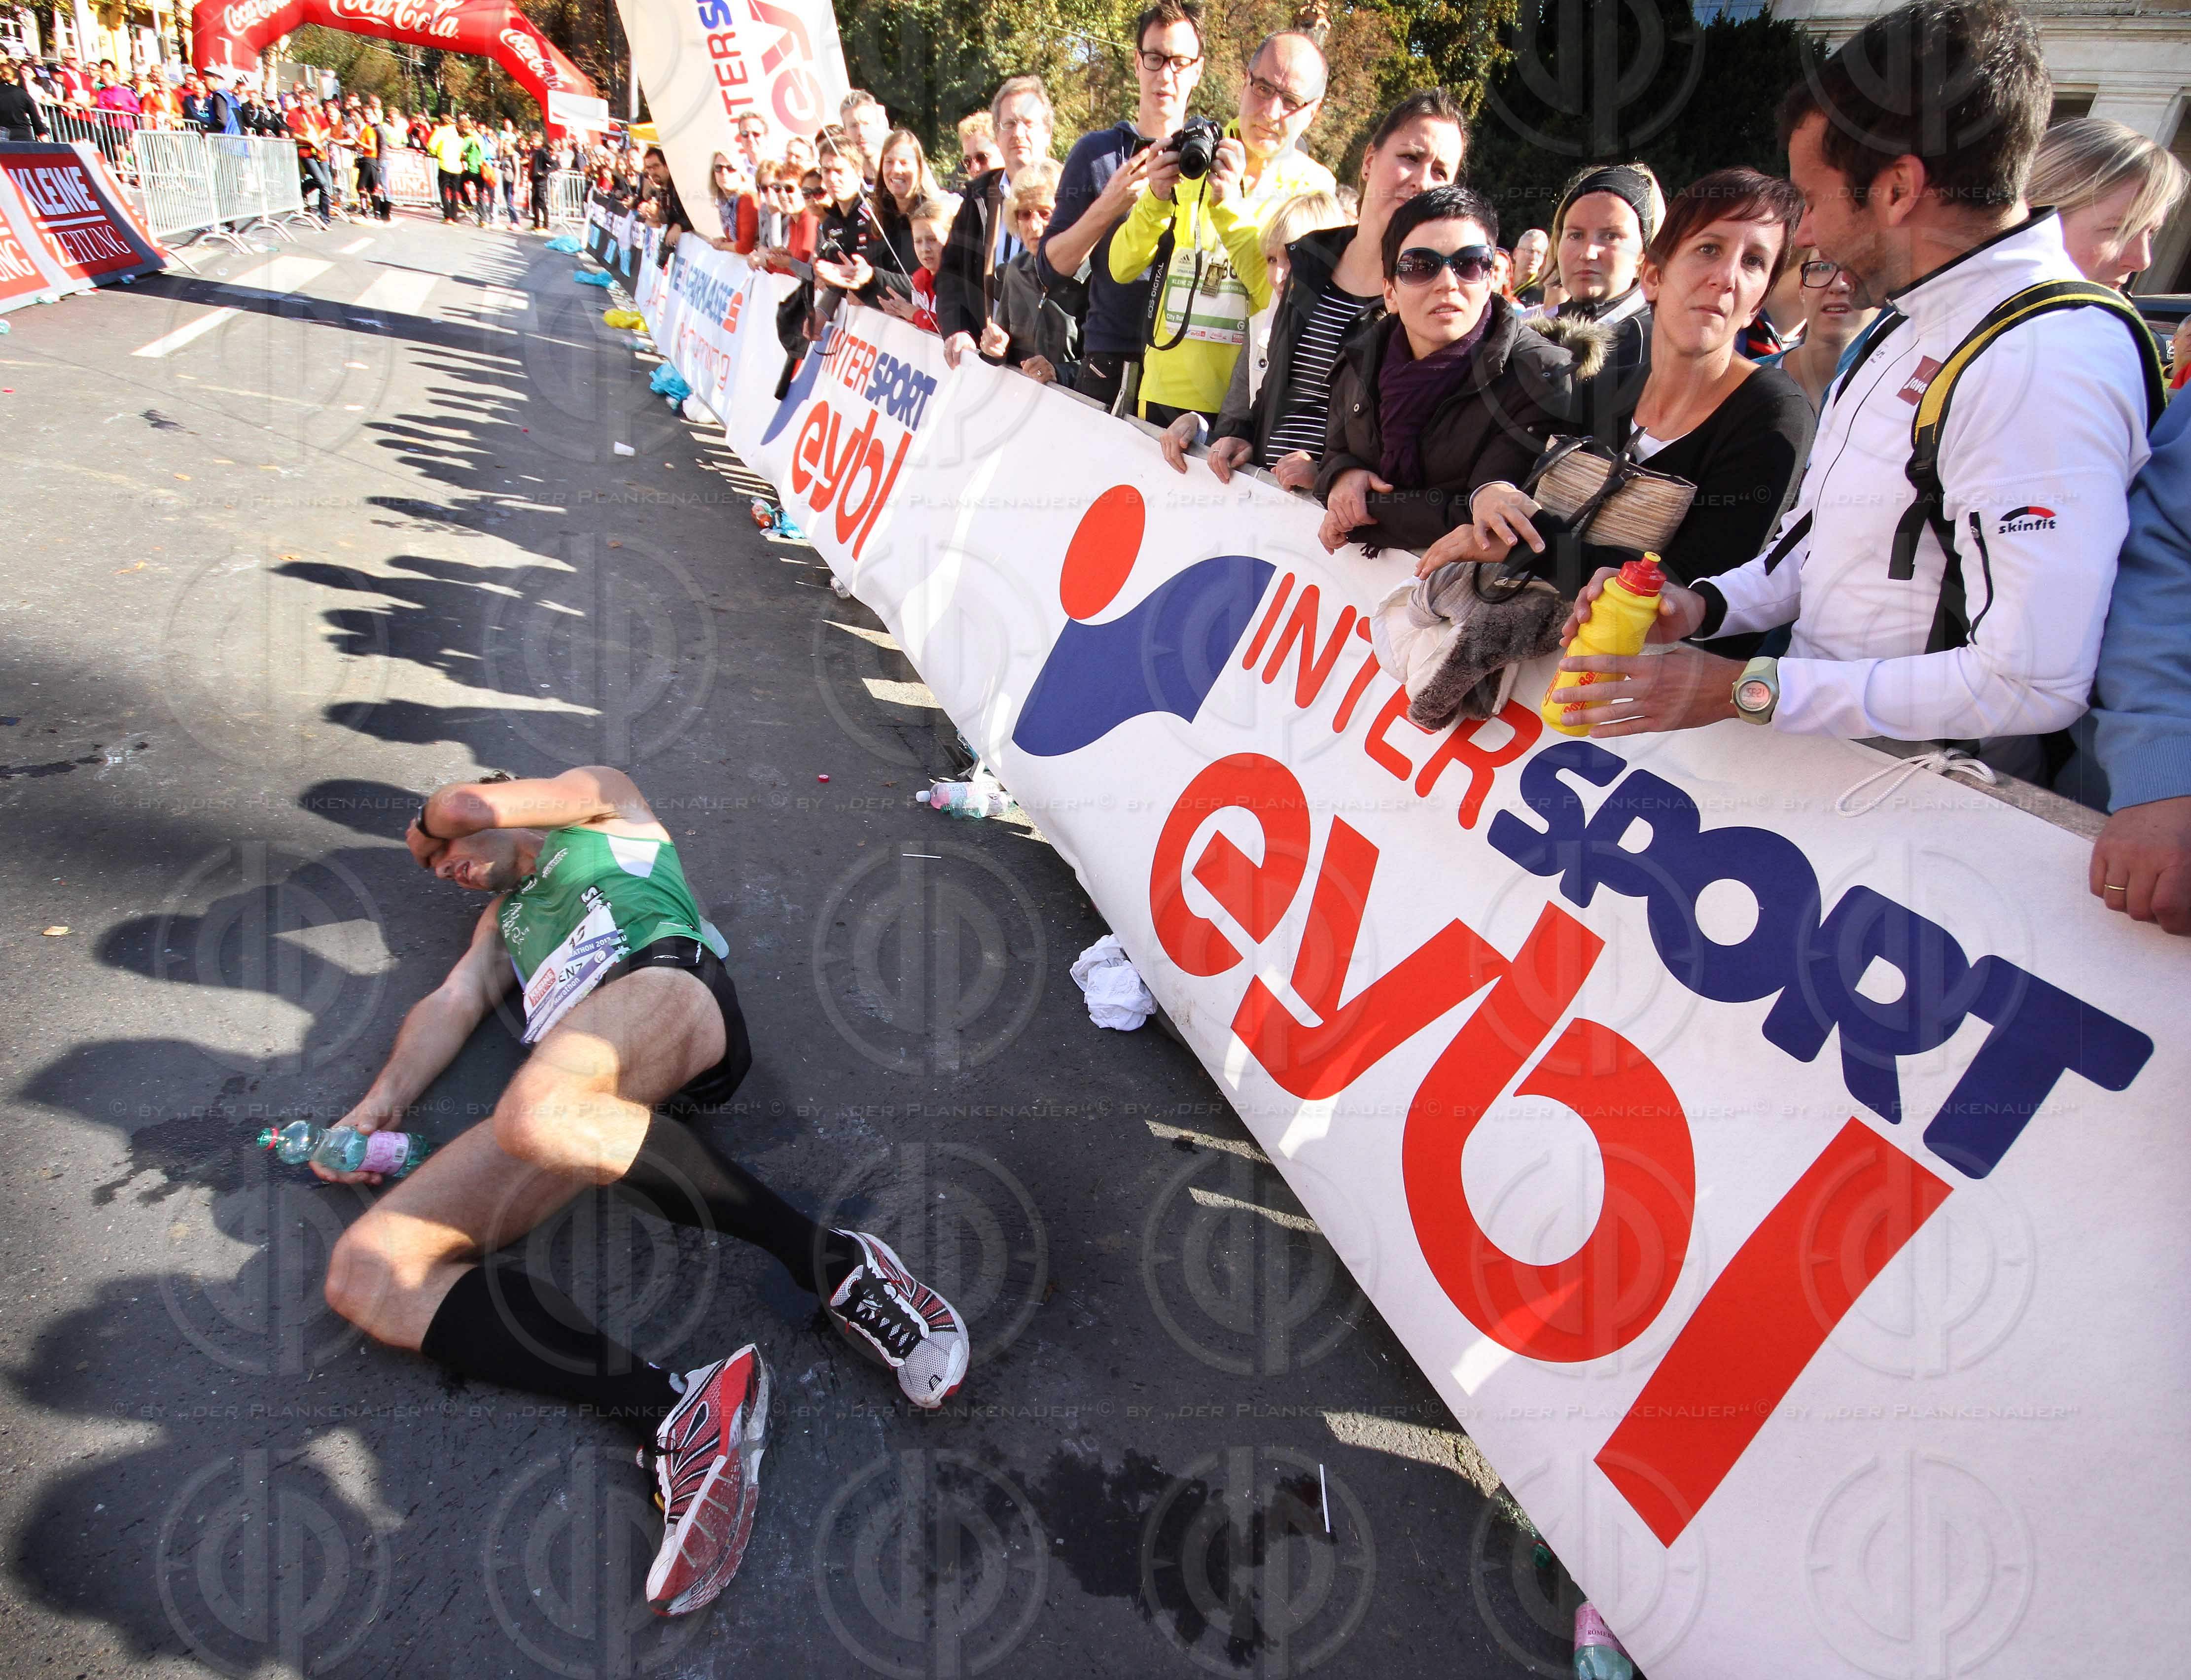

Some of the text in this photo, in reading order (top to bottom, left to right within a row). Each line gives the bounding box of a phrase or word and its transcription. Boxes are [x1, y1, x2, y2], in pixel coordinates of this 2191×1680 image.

[8, 166, 100, 217] KLEINE
[42, 225, 131, 268] ZEITUNG
[1151, 262, 1165, 296] DIGITAL
[822, 327, 938, 431] INTERSPORT
[792, 400, 913, 561] eybl
[1998, 519, 2056, 534] skinfit
[1241, 572, 2154, 1179] INTERSPORT
[554, 977, 580, 1005] Marathon
[1149, 752, 1954, 1548] eybl
